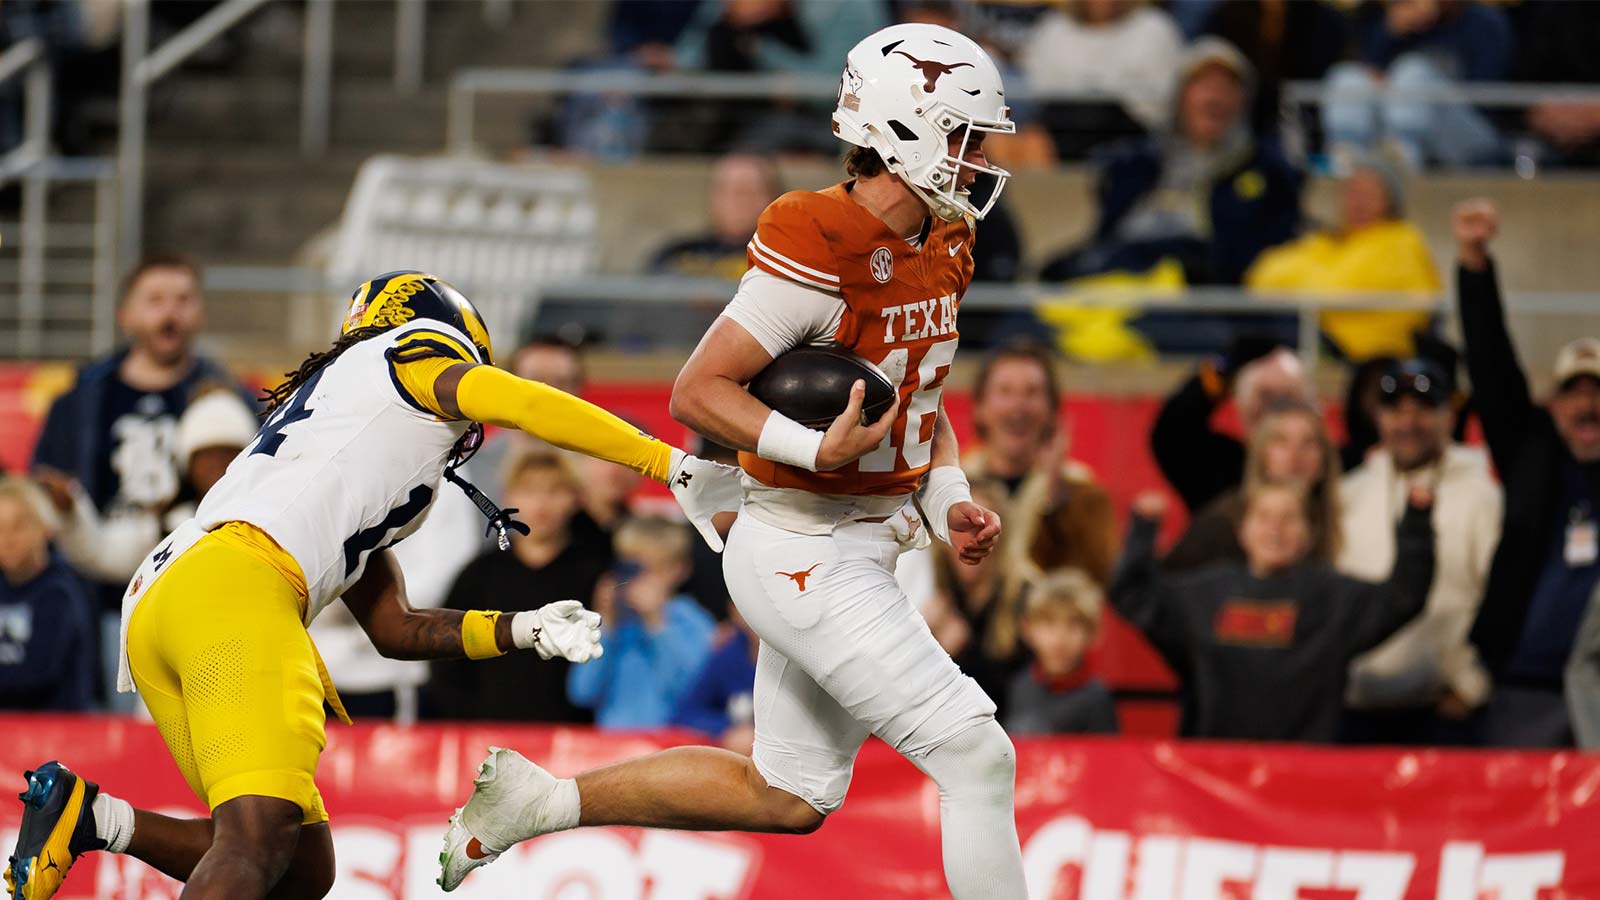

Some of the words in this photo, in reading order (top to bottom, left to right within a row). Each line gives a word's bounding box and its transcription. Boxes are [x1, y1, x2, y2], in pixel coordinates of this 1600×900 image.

[871, 247, 893, 281] SEC
[881, 292, 957, 343] TEXAS
[859, 338, 958, 472] 16
[677, 470, 693, 488] M
[153, 540, 174, 572] M
[532, 627, 542, 642] M
